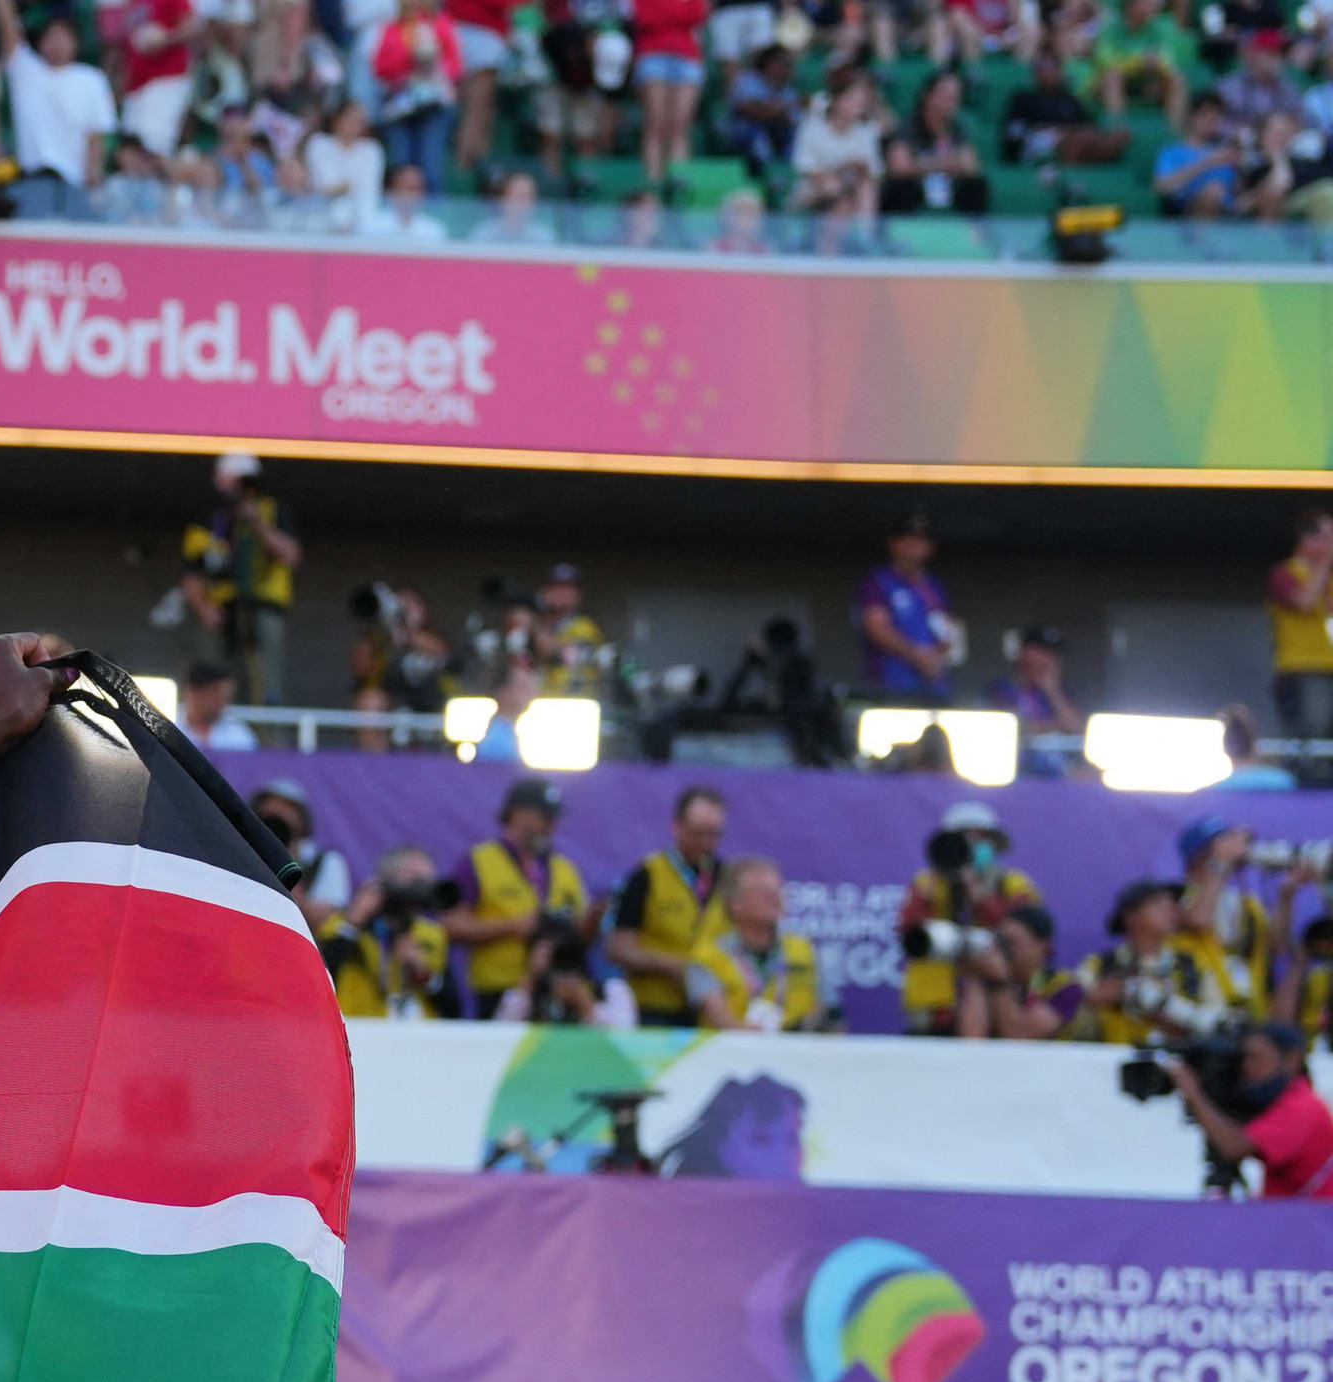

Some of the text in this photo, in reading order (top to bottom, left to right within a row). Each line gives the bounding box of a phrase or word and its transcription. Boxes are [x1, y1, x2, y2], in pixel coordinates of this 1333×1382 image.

[269, 303, 496, 394] Meet
[1008, 1262, 1333, 1306] WORLD ATHLETIC
[1009, 1302, 1333, 1348] CHAMPIONSHIP
